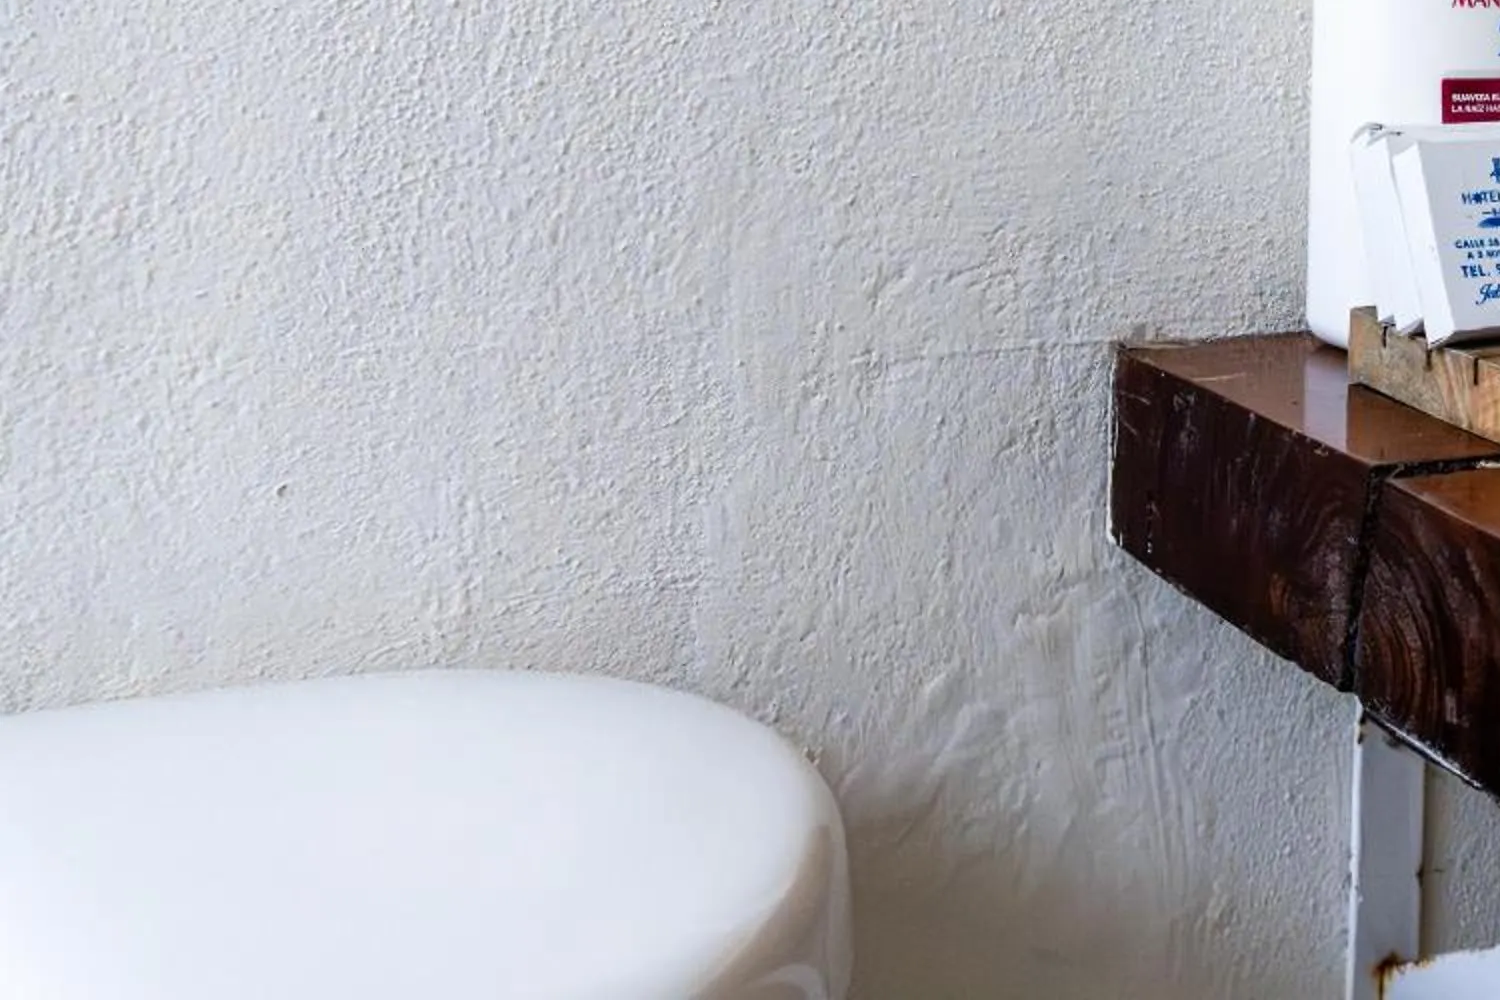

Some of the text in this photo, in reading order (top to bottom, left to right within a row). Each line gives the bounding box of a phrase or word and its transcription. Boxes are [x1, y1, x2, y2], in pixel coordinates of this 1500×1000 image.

[1455, 238, 1485, 249] CALLE
[1467, 250, 1475, 260] A
[1460, 264, 1491, 278] TEL.
